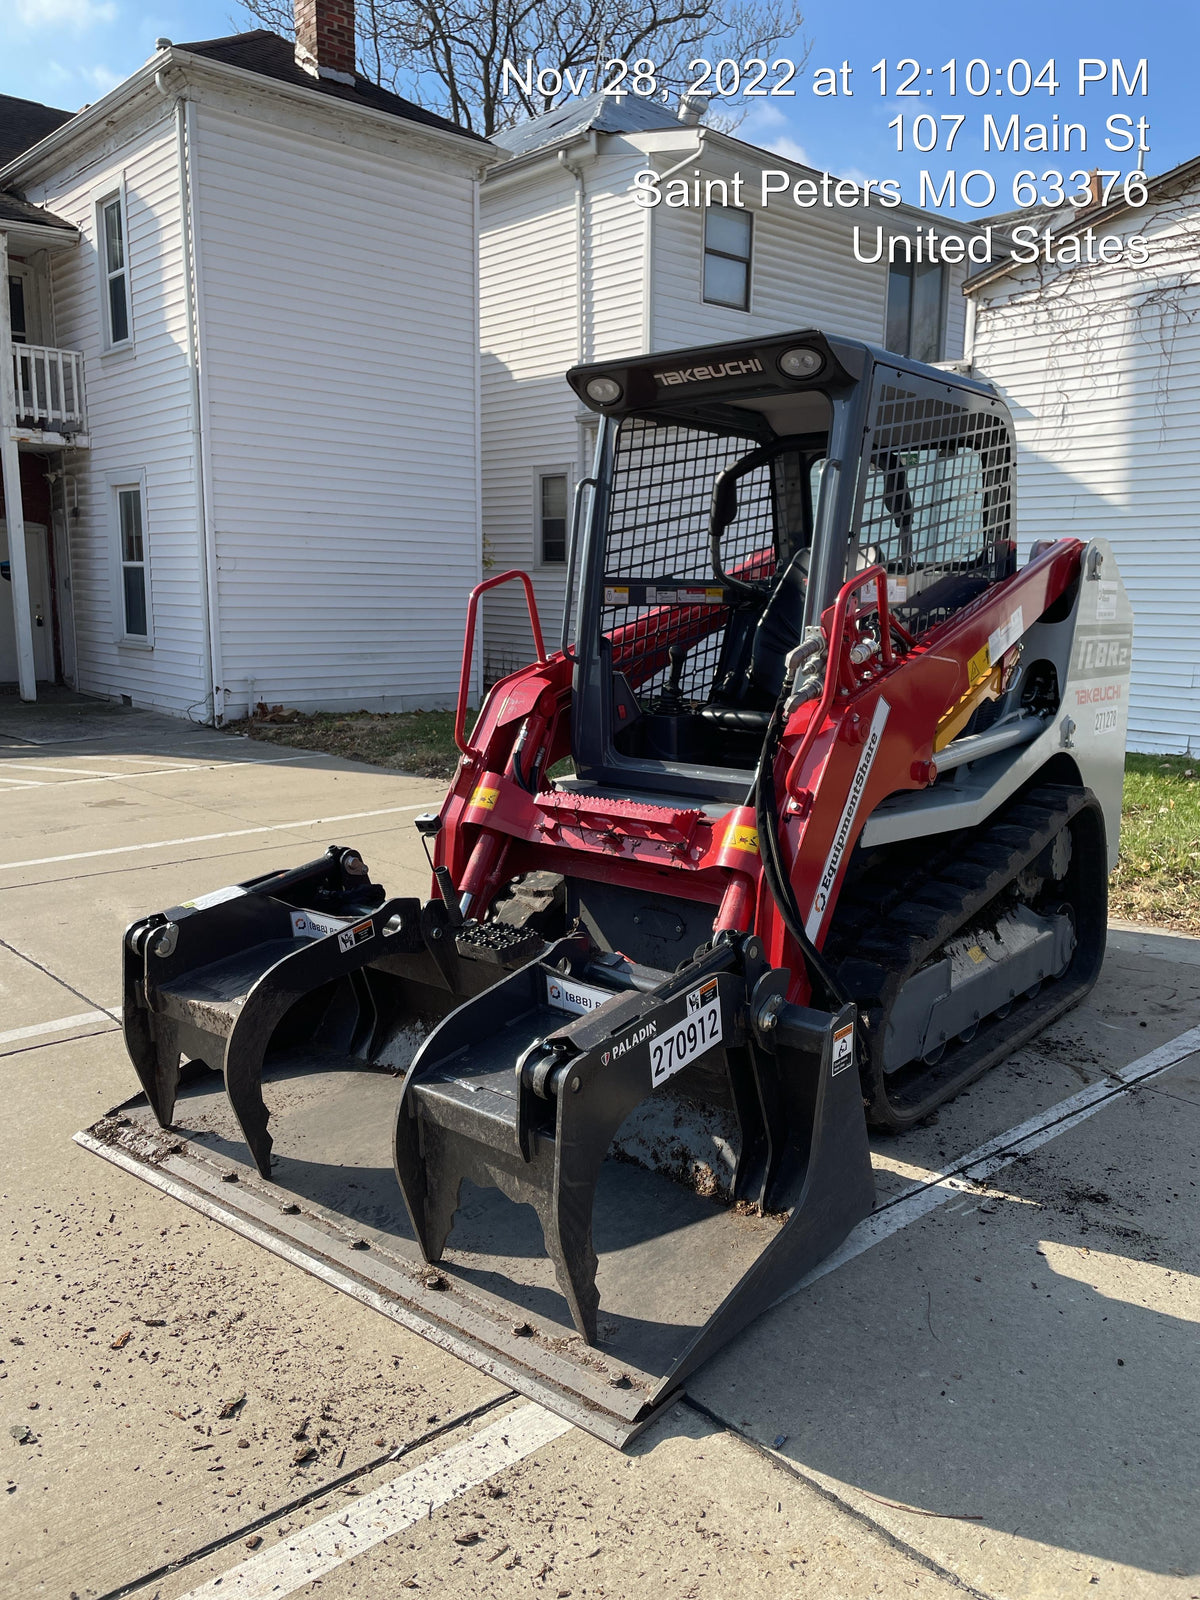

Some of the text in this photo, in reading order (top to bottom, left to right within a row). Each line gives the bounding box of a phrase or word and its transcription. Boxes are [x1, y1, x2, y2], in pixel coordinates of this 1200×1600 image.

[653, 358, 763, 386] TAKEUCHI
[1075, 685, 1121, 705] TAKEUCHI
[1095, 711, 1117, 731] 271278
[821, 731, 879, 893] EquipmentShare
[565, 991, 592, 1009] (888)
[612, 1020, 657, 1060] PALADIN
[652, 1008, 719, 1078] 270912
